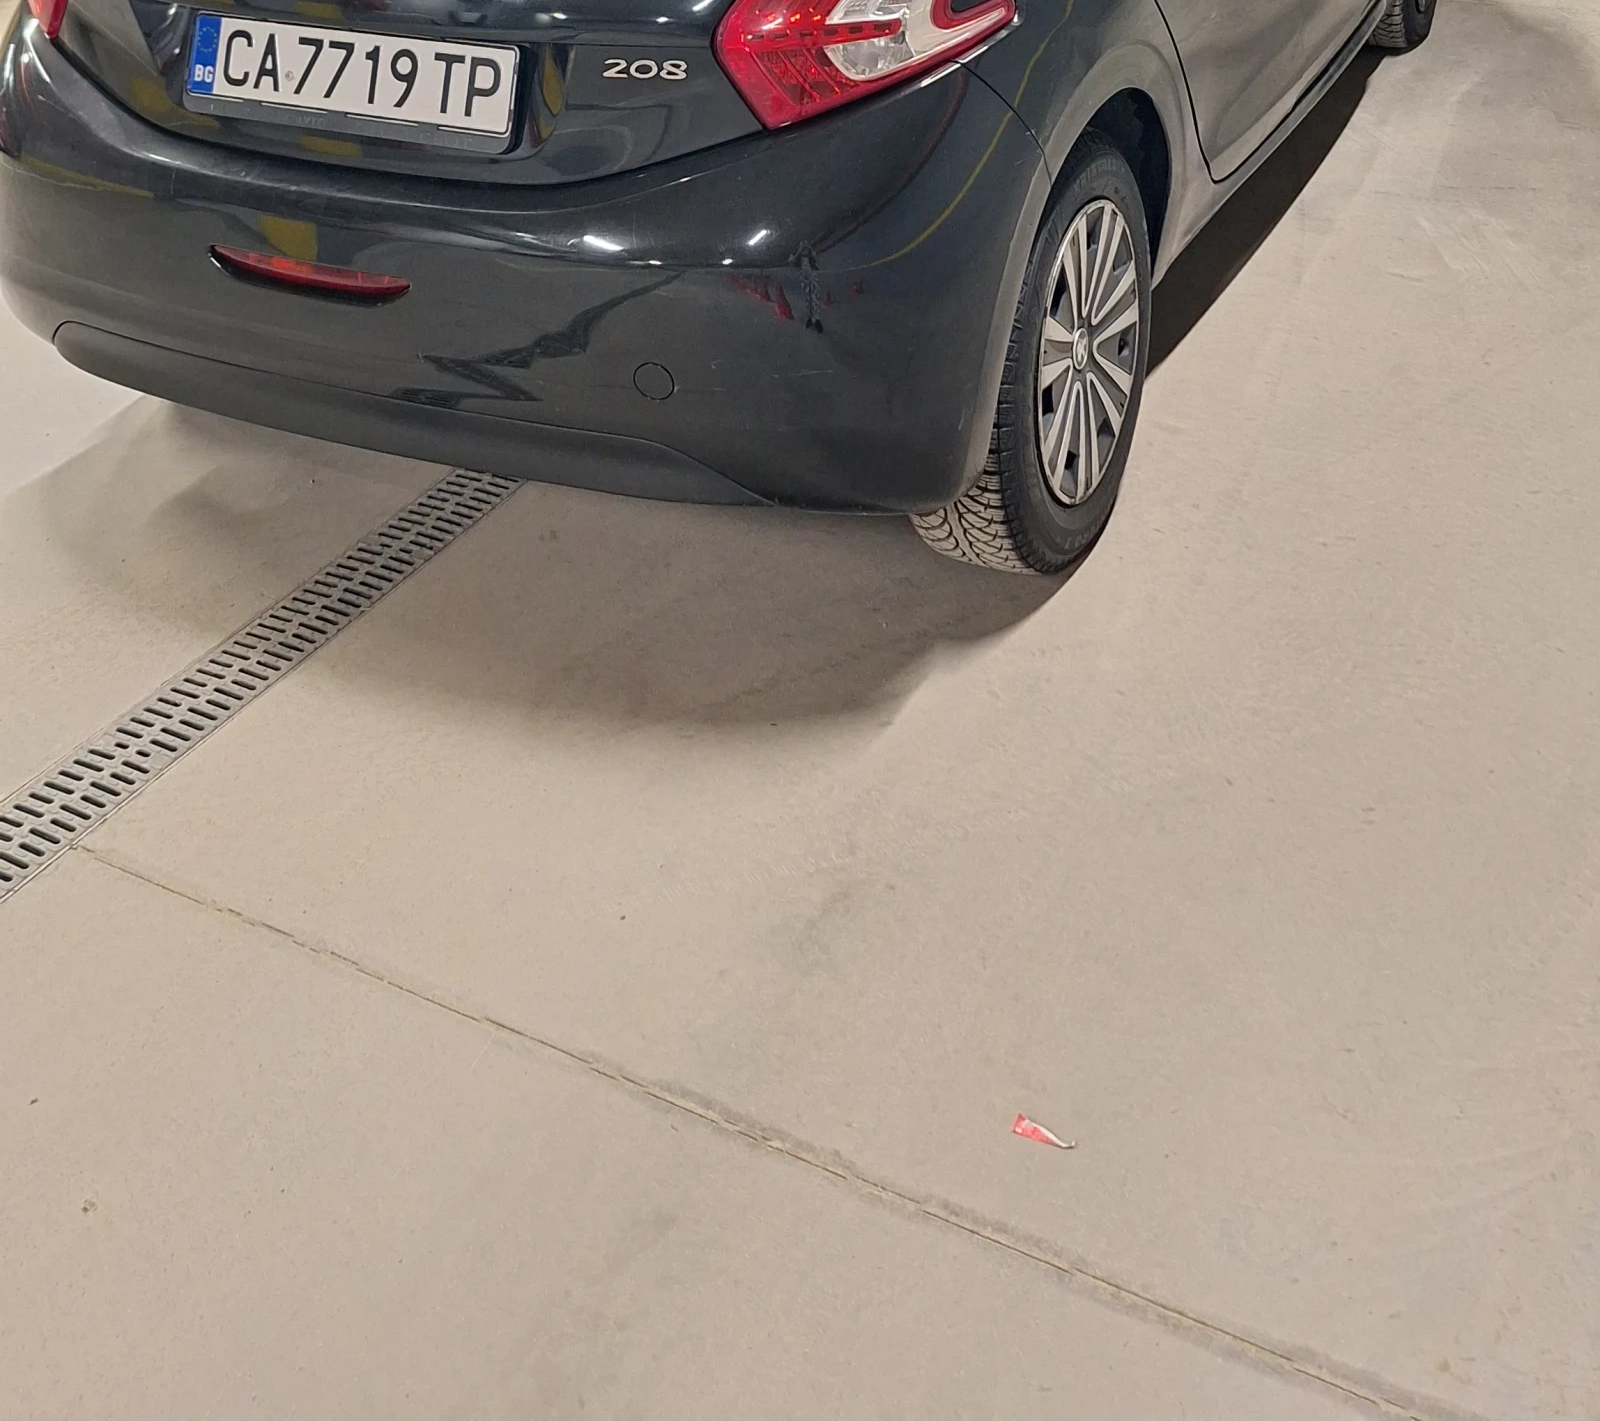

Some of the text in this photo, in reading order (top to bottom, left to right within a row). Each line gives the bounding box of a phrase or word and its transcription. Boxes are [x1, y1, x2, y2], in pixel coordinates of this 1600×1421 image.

[193, 64, 214, 82] BG
[223, 29, 502, 117] CA 7719 TP
[602, 58, 688, 80] 208
